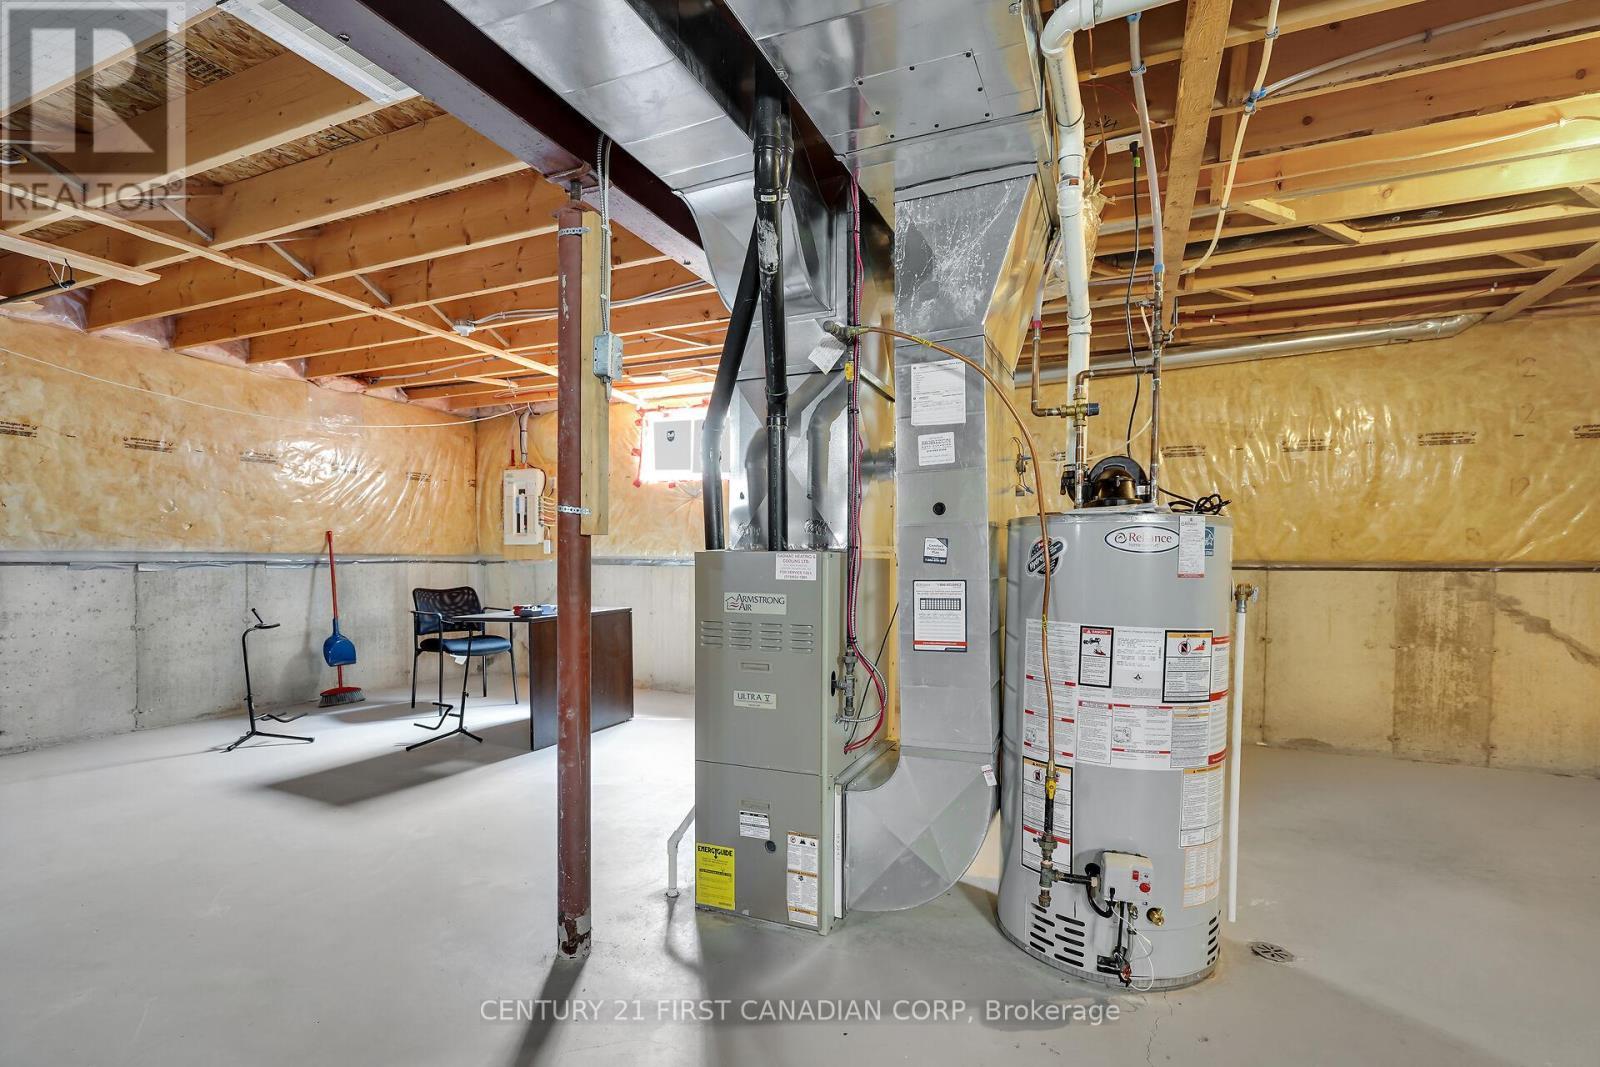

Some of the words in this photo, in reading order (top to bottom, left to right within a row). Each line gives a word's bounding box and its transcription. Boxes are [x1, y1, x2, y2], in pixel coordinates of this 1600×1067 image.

[736, 594, 785, 605] ARMSTRONG
[739, 602, 752, 611] AIR
[737, 692, 762, 701] ULTRA
